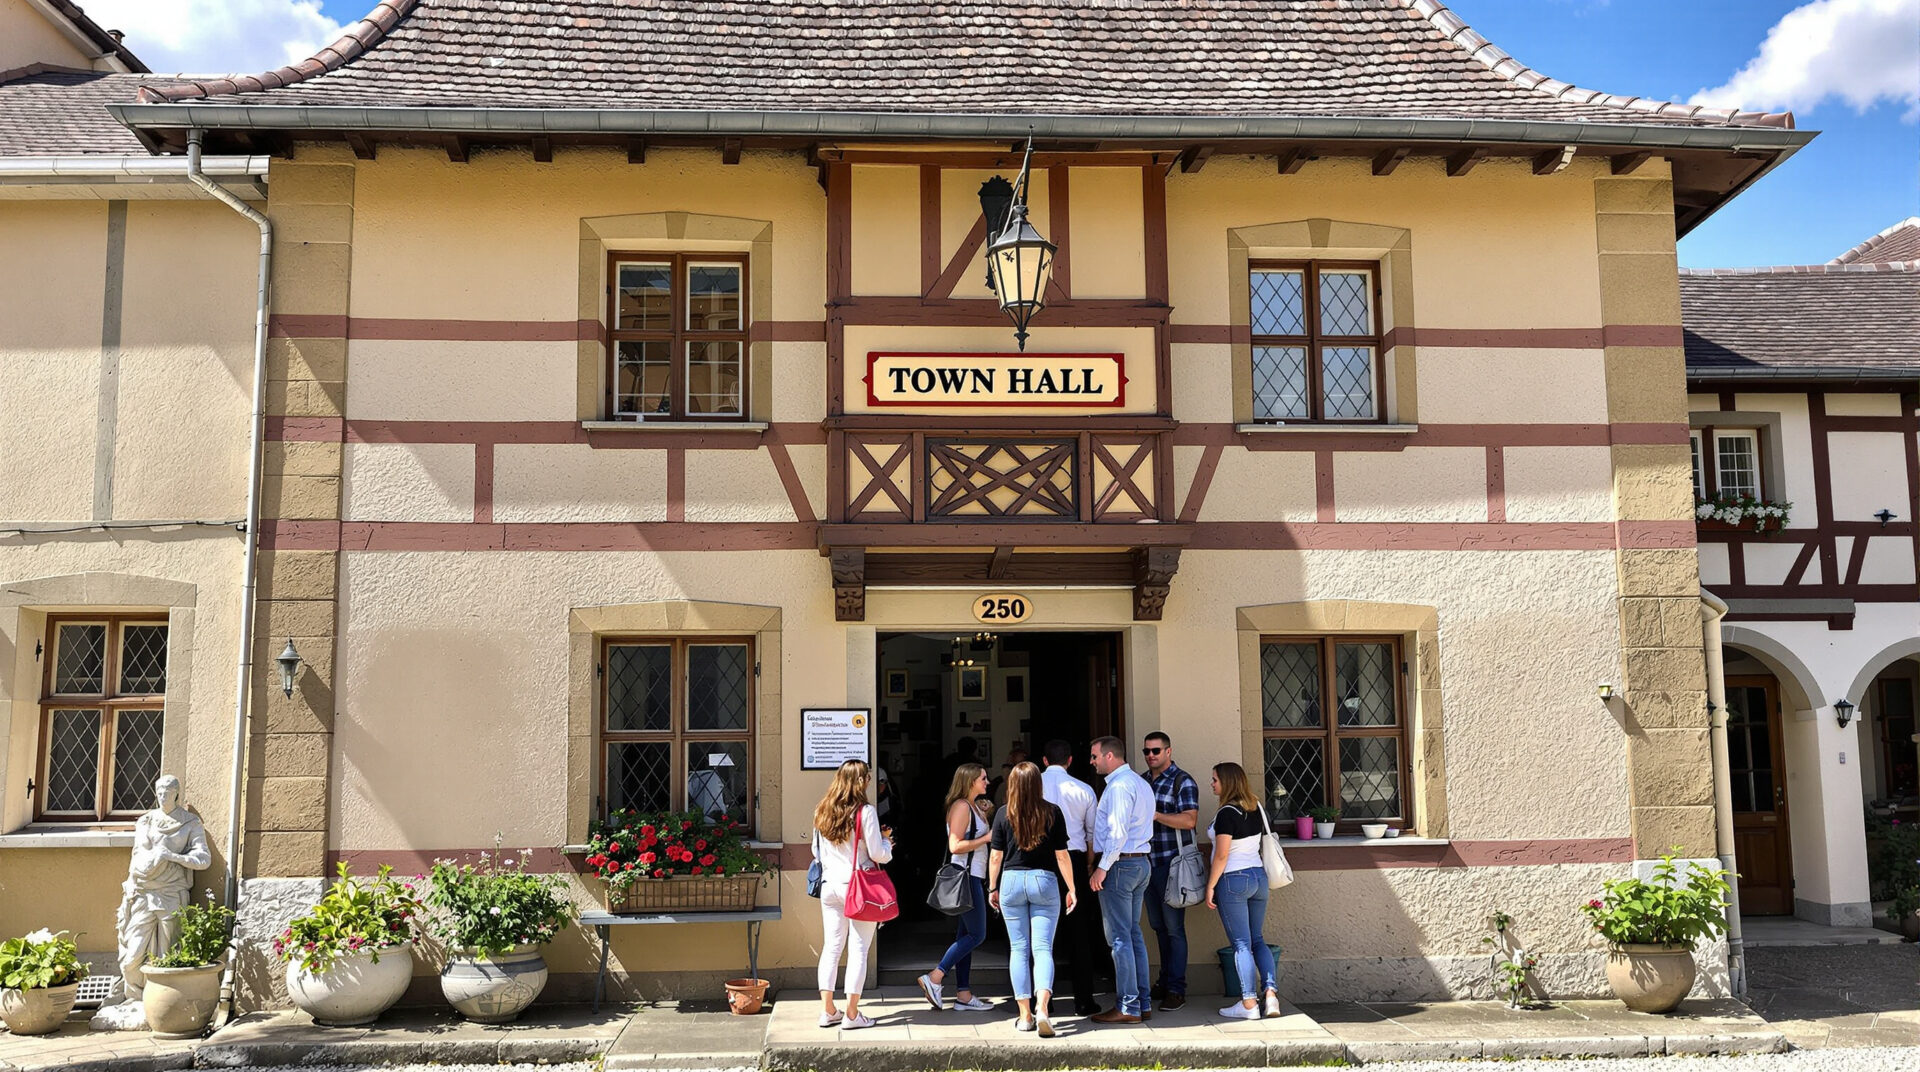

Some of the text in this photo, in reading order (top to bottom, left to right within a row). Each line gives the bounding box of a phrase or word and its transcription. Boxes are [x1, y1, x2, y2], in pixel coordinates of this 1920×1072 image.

[889, 368, 1103, 394] TOWN HALL
[981, 599, 1025, 619] 250
